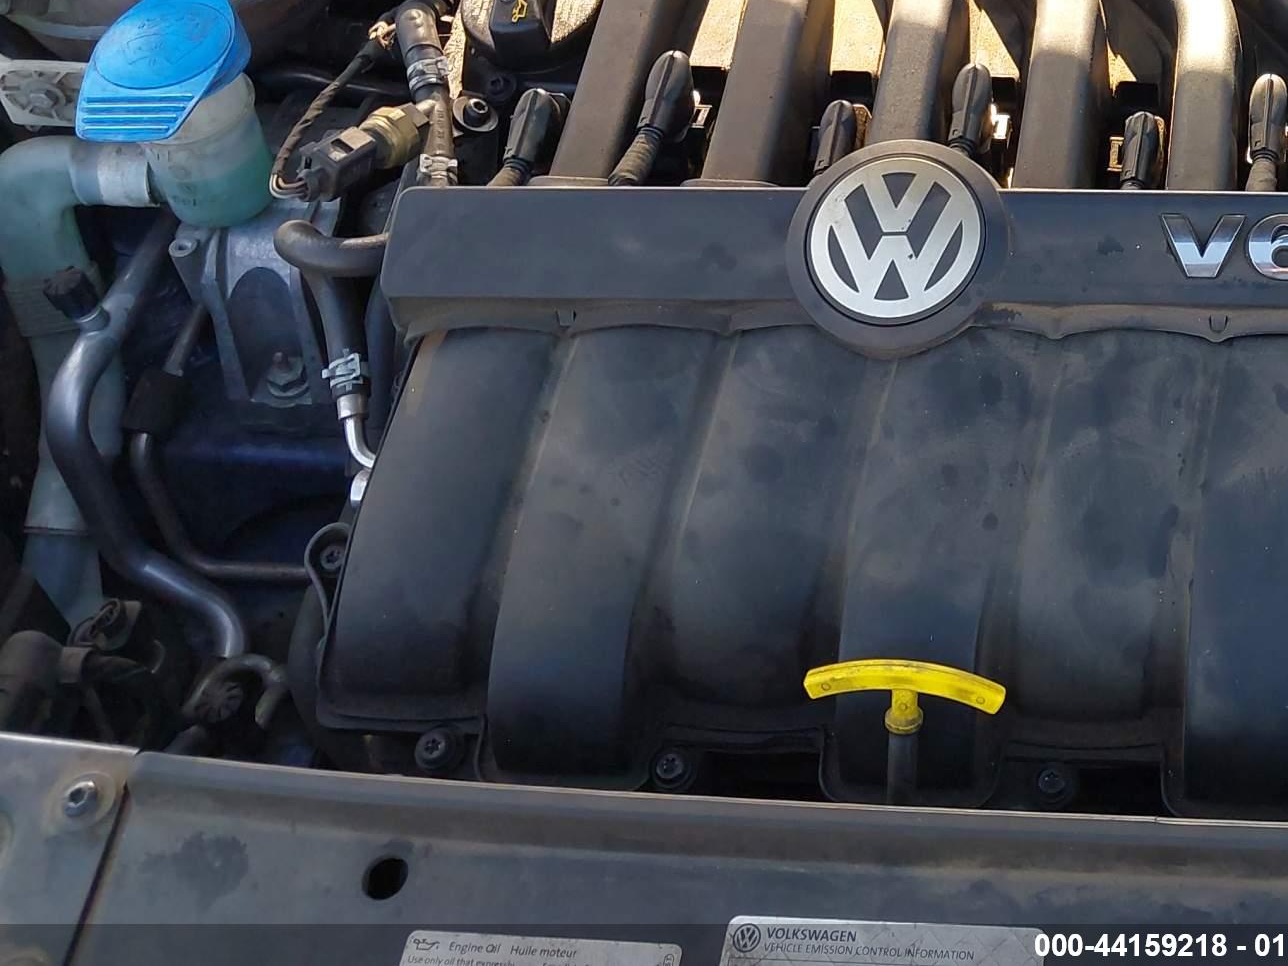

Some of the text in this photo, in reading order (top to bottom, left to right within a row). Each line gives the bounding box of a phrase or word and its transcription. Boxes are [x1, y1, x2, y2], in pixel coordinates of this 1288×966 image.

[767, 927, 857, 943] VOLKSWAGEN
[449, 941, 501, 955] Engine Oil
[510, 945, 577, 959] Huile moteur
[764, 942, 975, 960] VEHICLE EMISSION CONTROL INFORMATION
[407, 955, 423, 964] Use
[424, 955, 442, 966] only
[443, 957, 455, 965] oil
[456, 957, 474, 966] that
